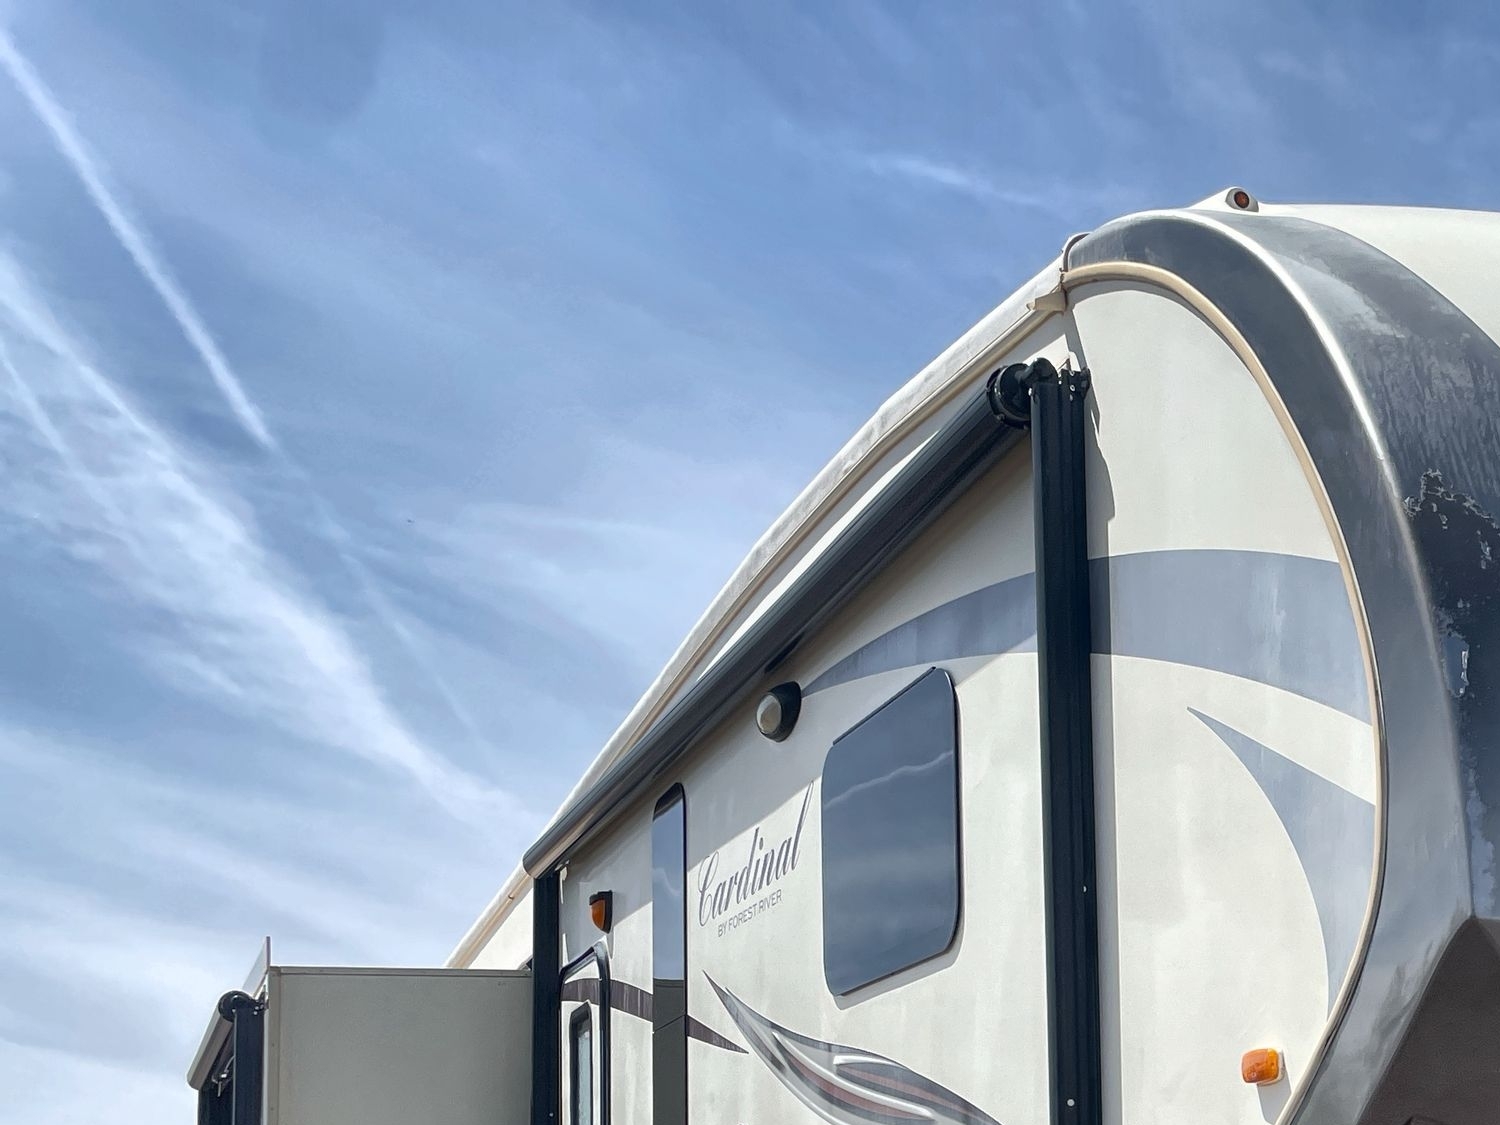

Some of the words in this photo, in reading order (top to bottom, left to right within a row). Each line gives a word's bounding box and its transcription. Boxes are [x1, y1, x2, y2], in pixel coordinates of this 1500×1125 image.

[697, 779, 815, 927] Cardinal
[717, 920, 728, 938] BY
[728, 902, 757, 931] FOREST
[758, 888, 782, 914] RIVER
